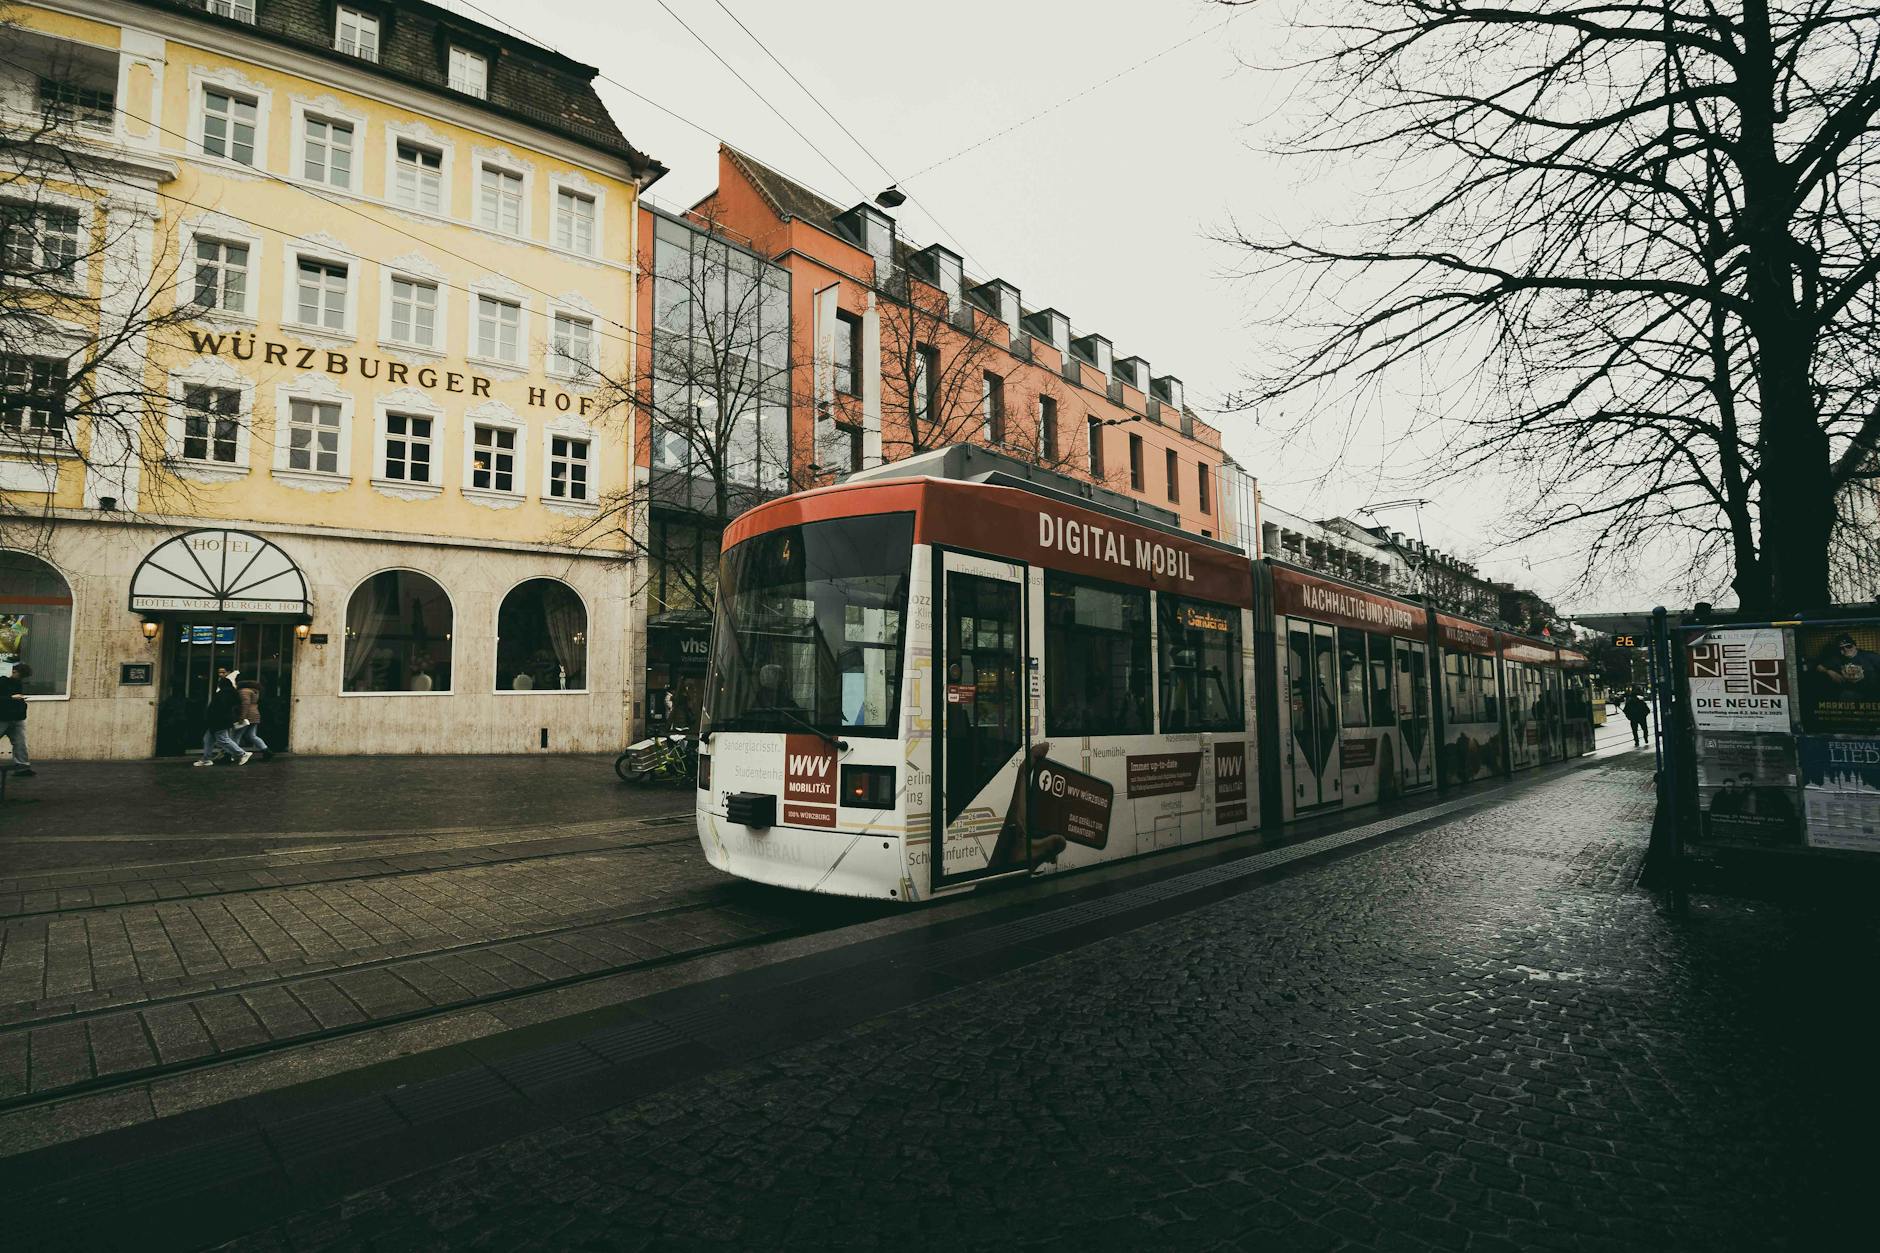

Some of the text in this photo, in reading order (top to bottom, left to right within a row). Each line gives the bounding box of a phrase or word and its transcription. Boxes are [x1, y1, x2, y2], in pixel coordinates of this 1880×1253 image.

[188, 331, 595, 416] WÜRZBURGER HOF
[1039, 512, 1195, 581] DIGITAL MOBIL
[135, 598, 177, 608] HOTEL
[1302, 584, 1413, 631] NACHHALTIG UND SAUBER
[681, 637, 708, 654] vhs
[1615, 636, 1634, 647] 26
[1696, 698, 1782, 709] DIE NEUEN
[1092, 746, 1126, 758] Neumühle
[1828, 741, 1880, 750] FESTIVAL
[789, 754, 832, 778] WVV
[1217, 755, 1243, 778] WVV
[789, 782, 832, 795] MOBILITÄT
